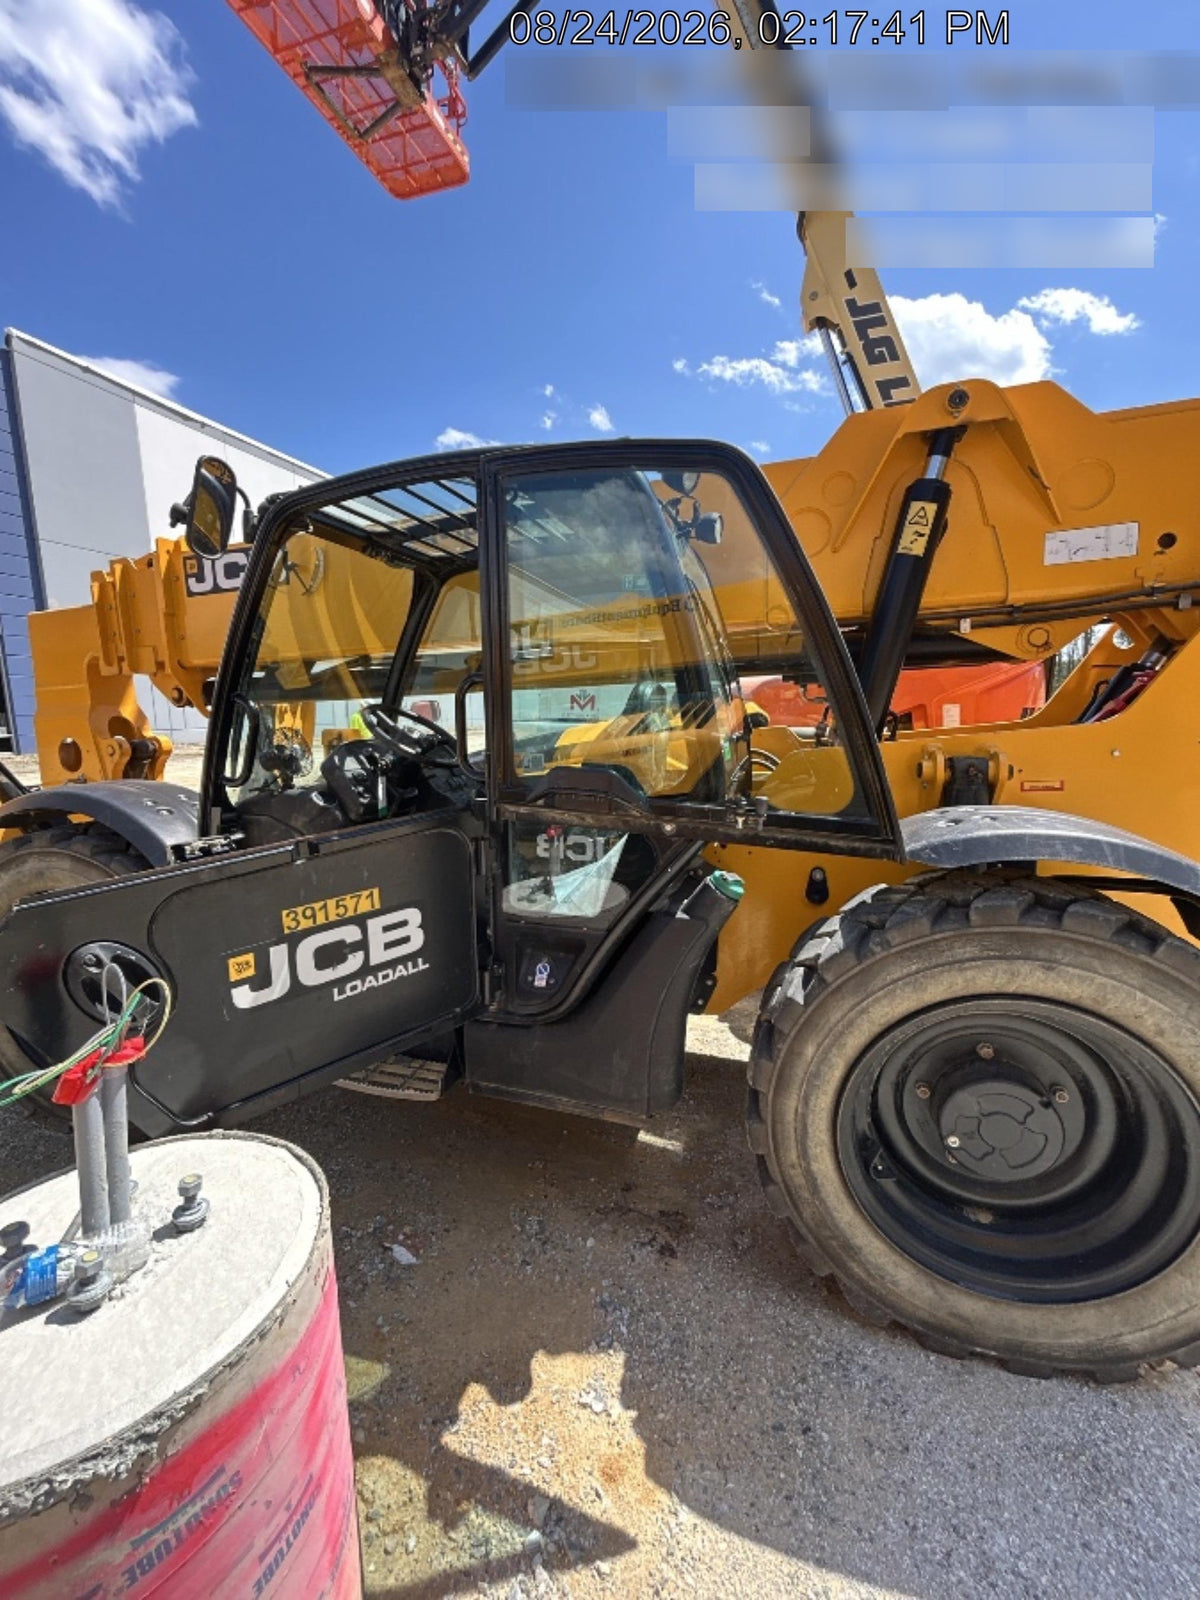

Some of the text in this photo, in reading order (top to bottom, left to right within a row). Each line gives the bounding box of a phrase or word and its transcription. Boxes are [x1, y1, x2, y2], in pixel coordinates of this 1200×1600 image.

[844, 297, 900, 366] JLG
[187, 552, 248, 593] JC
[285, 889, 376, 932] 391571
[231, 907, 426, 1009] JCB
[333, 957, 430, 1002] LOADALL
